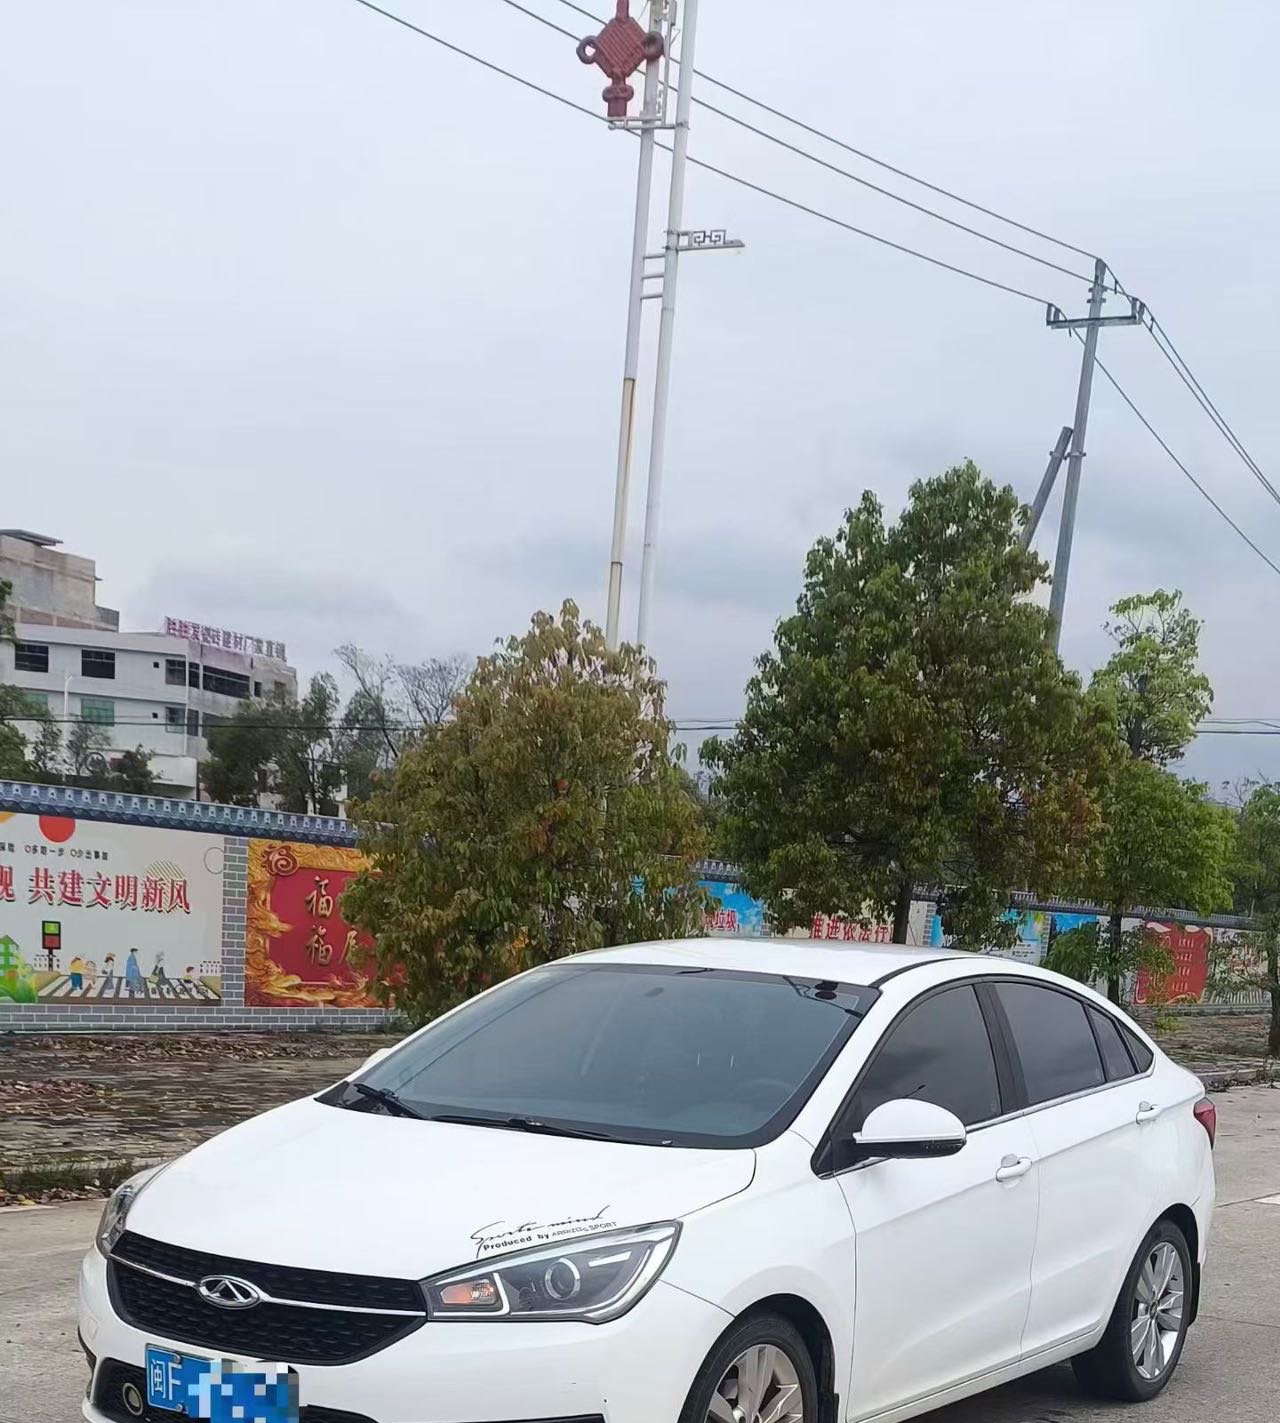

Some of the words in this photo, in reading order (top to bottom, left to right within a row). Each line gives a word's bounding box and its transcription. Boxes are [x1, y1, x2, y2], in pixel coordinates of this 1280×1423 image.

[28, 866, 191, 914] 共建文明新风
[811, 912, 893, 943] 推进依法行
[483, 1236, 532, 1251] Produced
